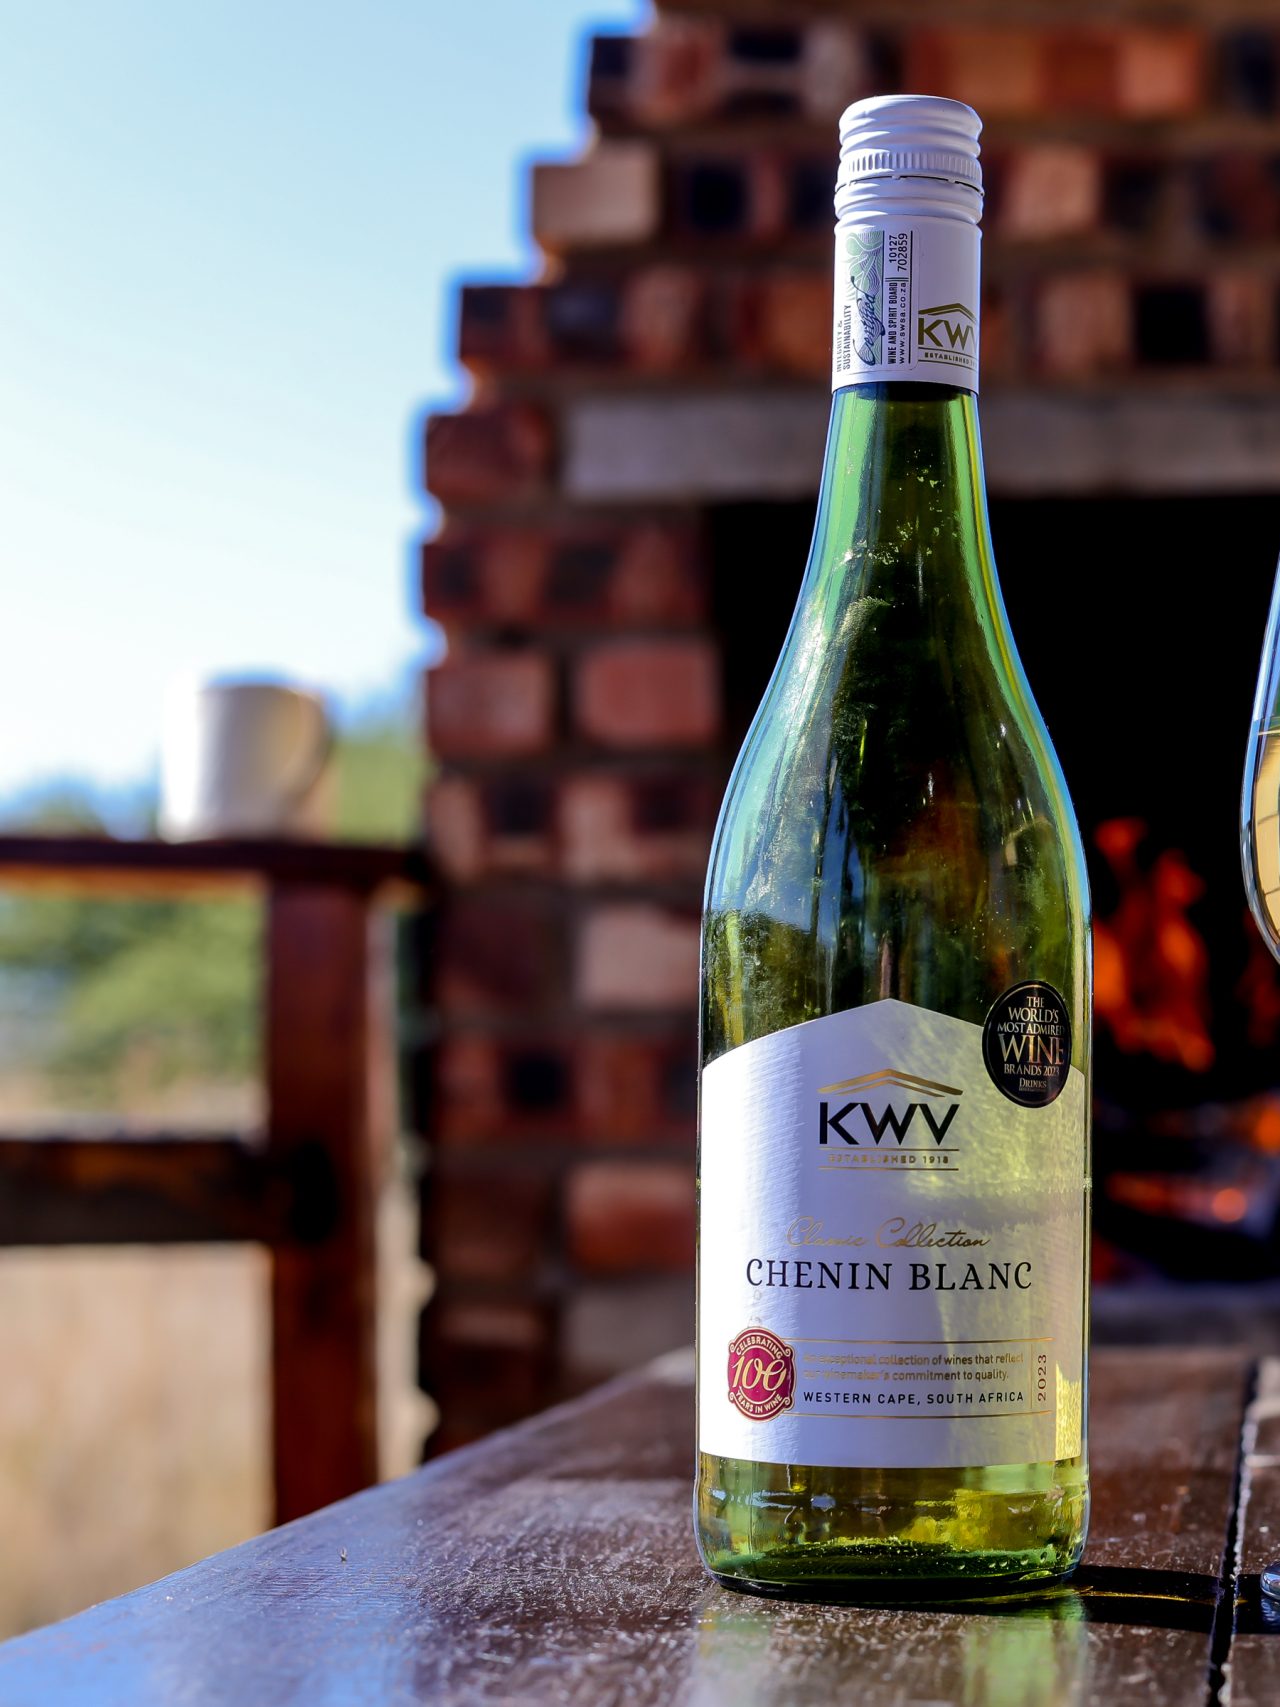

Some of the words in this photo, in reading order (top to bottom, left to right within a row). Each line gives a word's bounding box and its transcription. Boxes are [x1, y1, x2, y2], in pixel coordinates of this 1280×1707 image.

[889, 235, 897, 263] 10127
[898, 233, 908, 272] 702859
[889, 282, 898, 304] BOARD
[851, 276, 886, 366] Certified
[888, 307, 898, 328] SPIRIT
[843, 305, 852, 370] SUSTAINABILITY
[888, 330, 897, 345] AND
[888, 346, 897, 364] WINE
[924, 352, 970, 365] ESTABLISHED
[1026, 996, 1045, 1008] THE
[1008, 1006, 1059, 1023] WORLD'S
[997, 1022, 1026, 1034] MOST
[1026, 1023, 1065, 1036] ADMIRED
[998, 1033, 1065, 1065] WINE
[1004, 1063, 1042, 1076] BRANDS
[1043, 1066, 1060, 1077] 2023
[819, 1102, 960, 1146] KWV
[828, 1154, 916, 1164] ESTABLISHED
[922, 1155, 949, 1164] 1918
[875, 1216, 992, 1249] Collection
[746, 1258, 893, 1291] CHENIN
[908, 1261, 1032, 1291] BLANC
[735, 1336, 783, 1359] CELEBRATING
[879, 1354, 930, 1366] collection
[932, 1354, 942, 1366] of
[943, 1354, 973, 1366] wines
[975, 1353, 993, 1365] that
[995, 1352, 1024, 1364] reflect
[732, 1355, 787, 1391] 100
[892, 1370, 960, 1381] commitment
[963, 1371, 973, 1381] to
[975, 1369, 1009, 1382] quality.
[1037, 1354, 1047, 1402] 2023
[735, 1390, 754, 1413] YEARS
[763, 1393, 783, 1412] WINE
[803, 1391, 871, 1404] WESTERN
[877, 1393, 921, 1406] CAPE,
[927, 1393, 973, 1405] SOUTH
[978, 1391, 1024, 1403] AFRICA
